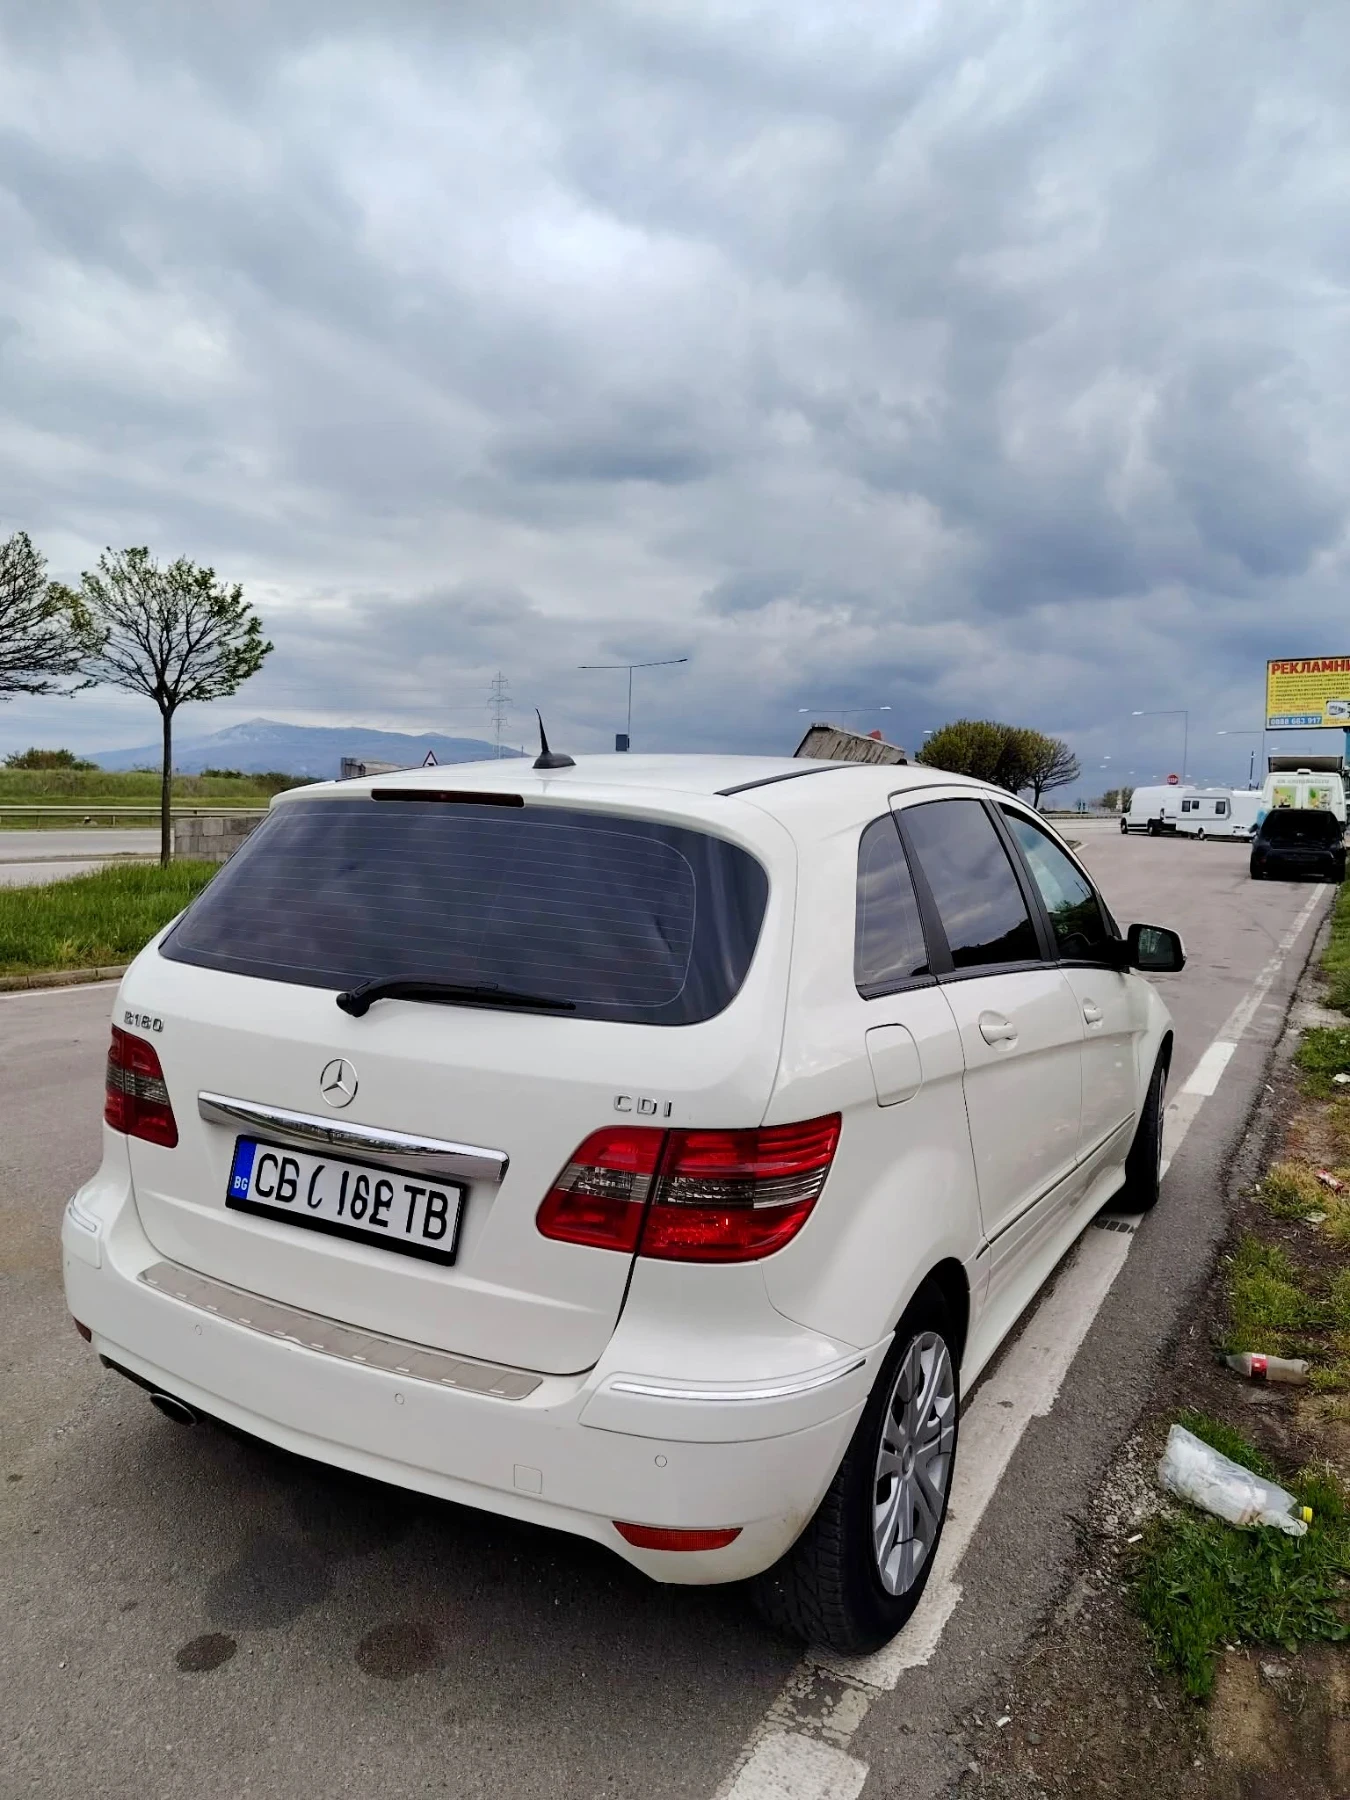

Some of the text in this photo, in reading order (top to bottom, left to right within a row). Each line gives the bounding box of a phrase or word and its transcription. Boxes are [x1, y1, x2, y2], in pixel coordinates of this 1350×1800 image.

[614, 1094, 672, 1118] CDI
[233, 1175, 249, 1191] BG
[404, 1184, 448, 1240] TB
